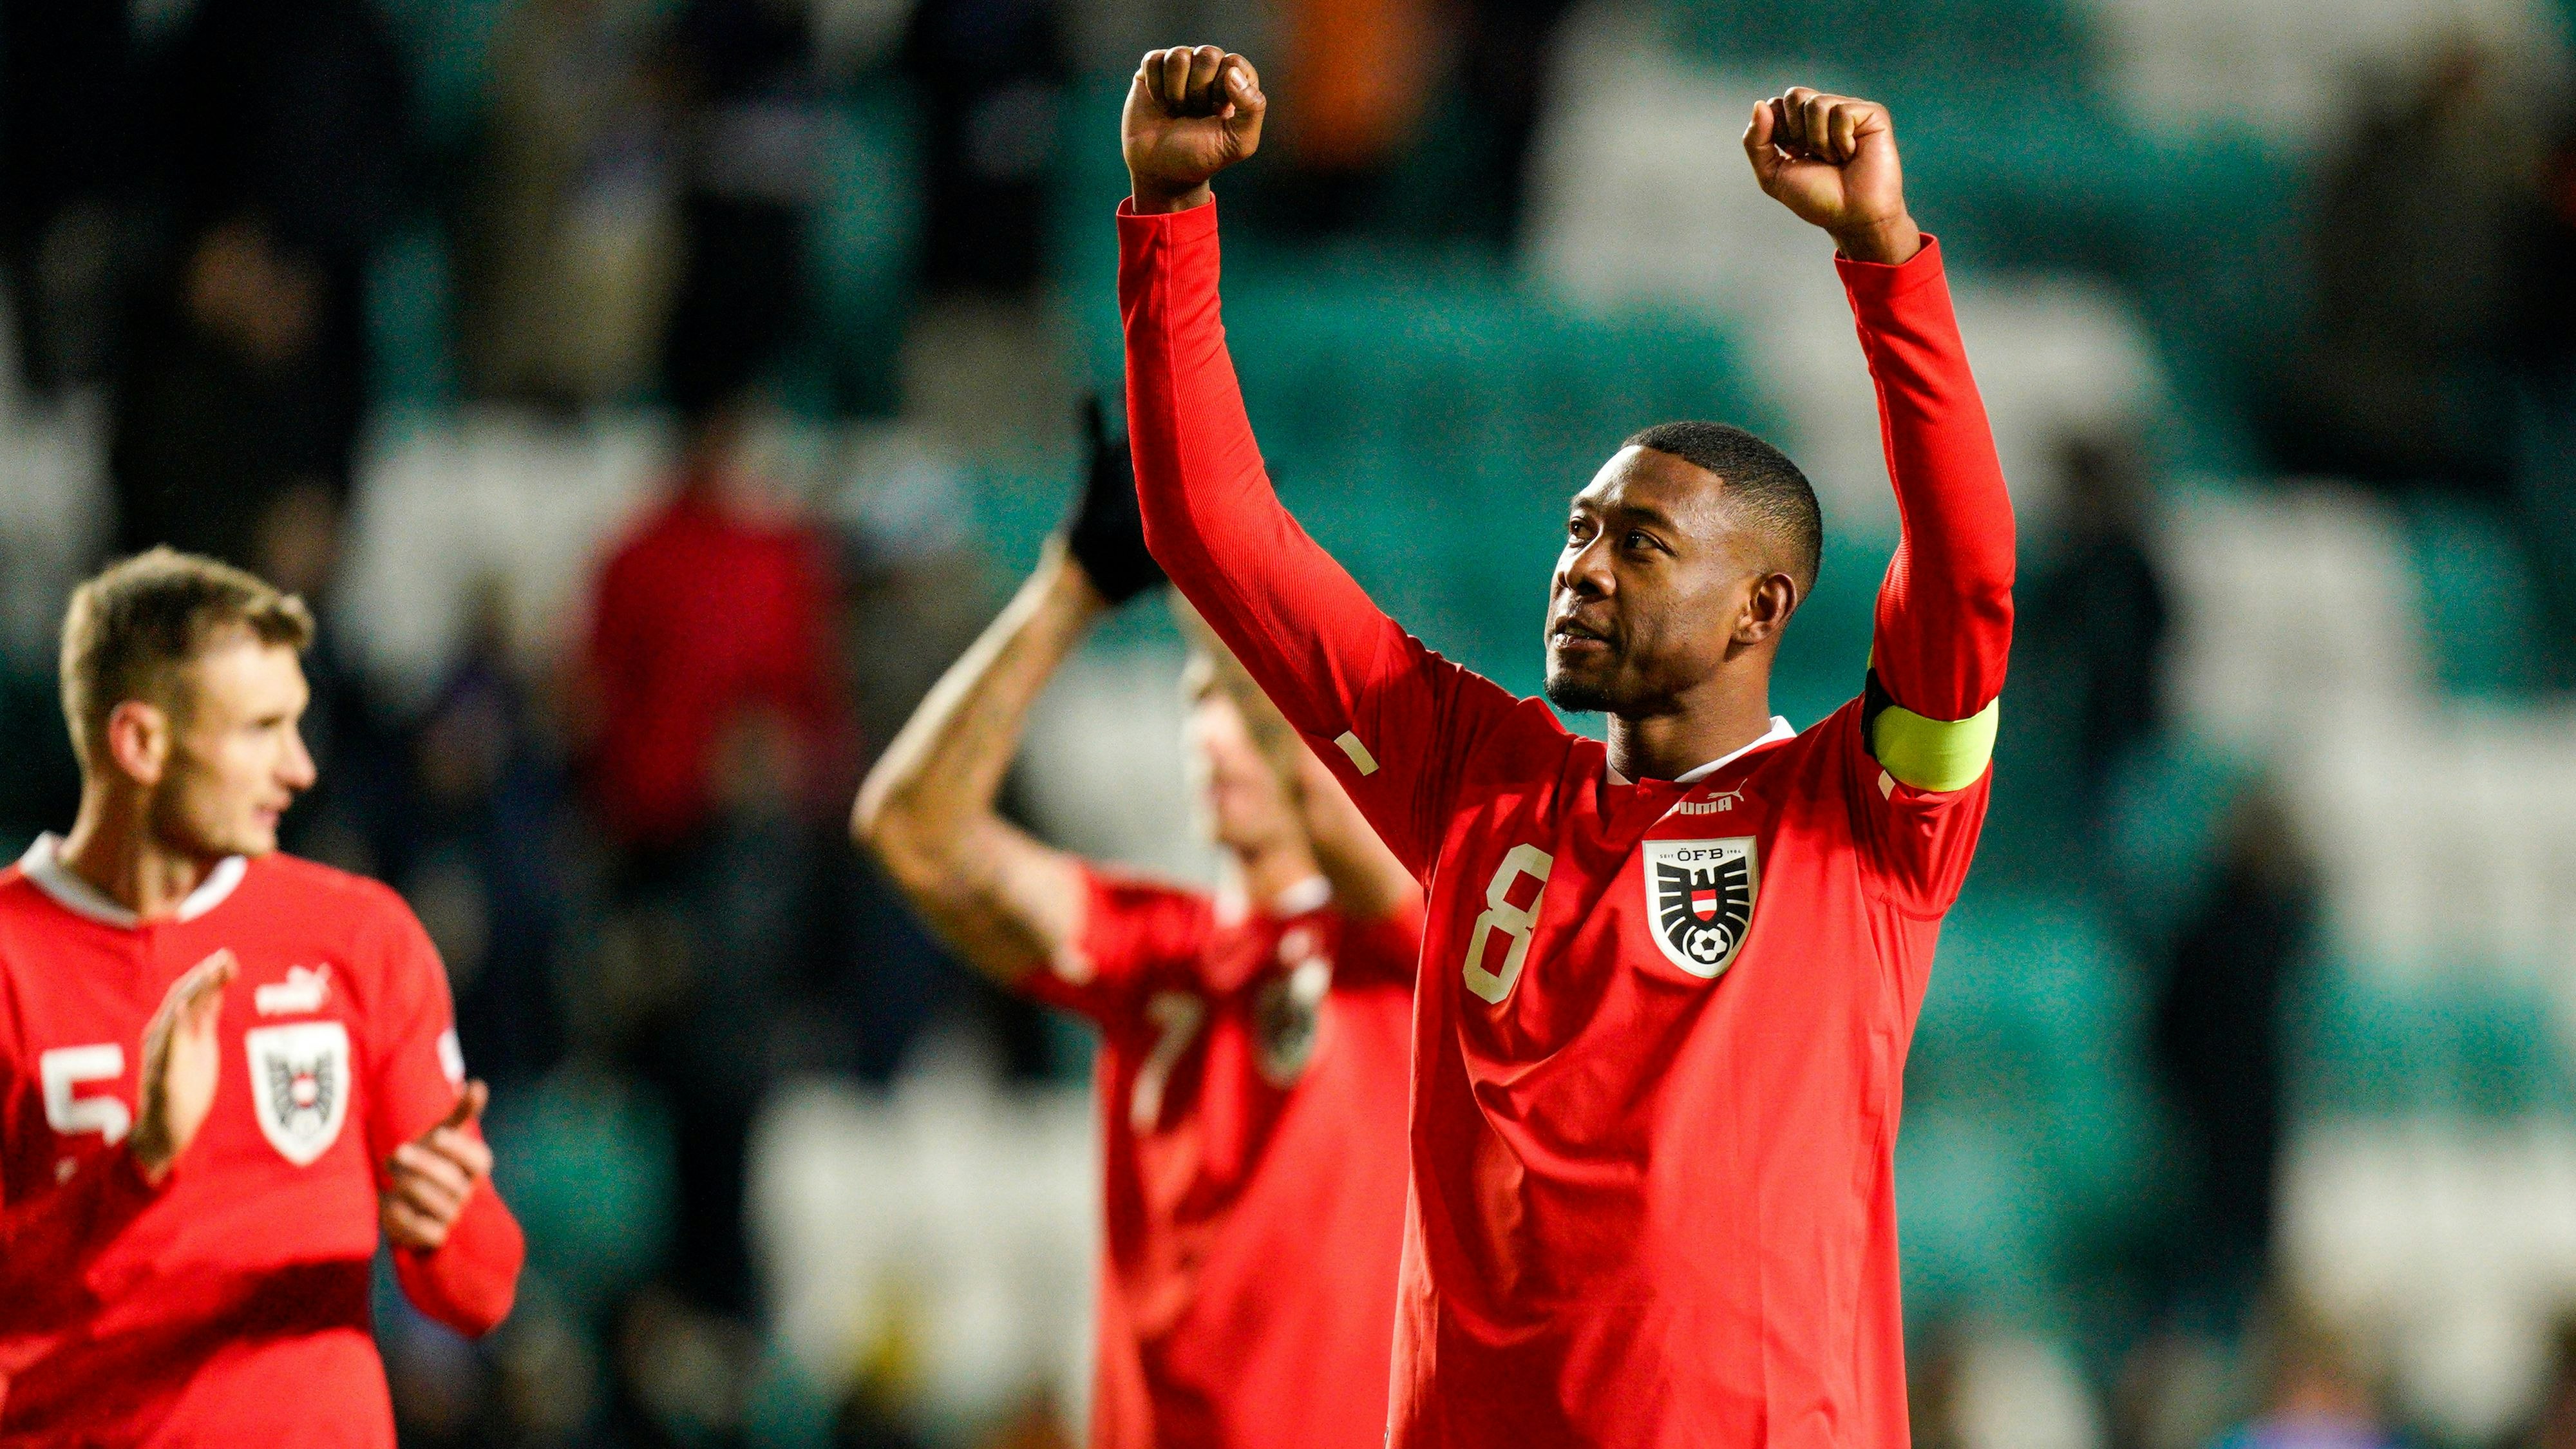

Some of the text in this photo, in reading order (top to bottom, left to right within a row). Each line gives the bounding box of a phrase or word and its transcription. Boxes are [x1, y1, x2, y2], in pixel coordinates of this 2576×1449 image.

[1462, 843, 1554, 1005] 8
[1678, 848, 1723, 861] ÖFB
[40, 1042, 131, 1185] 5
[1130, 991, 1206, 1137] 7
